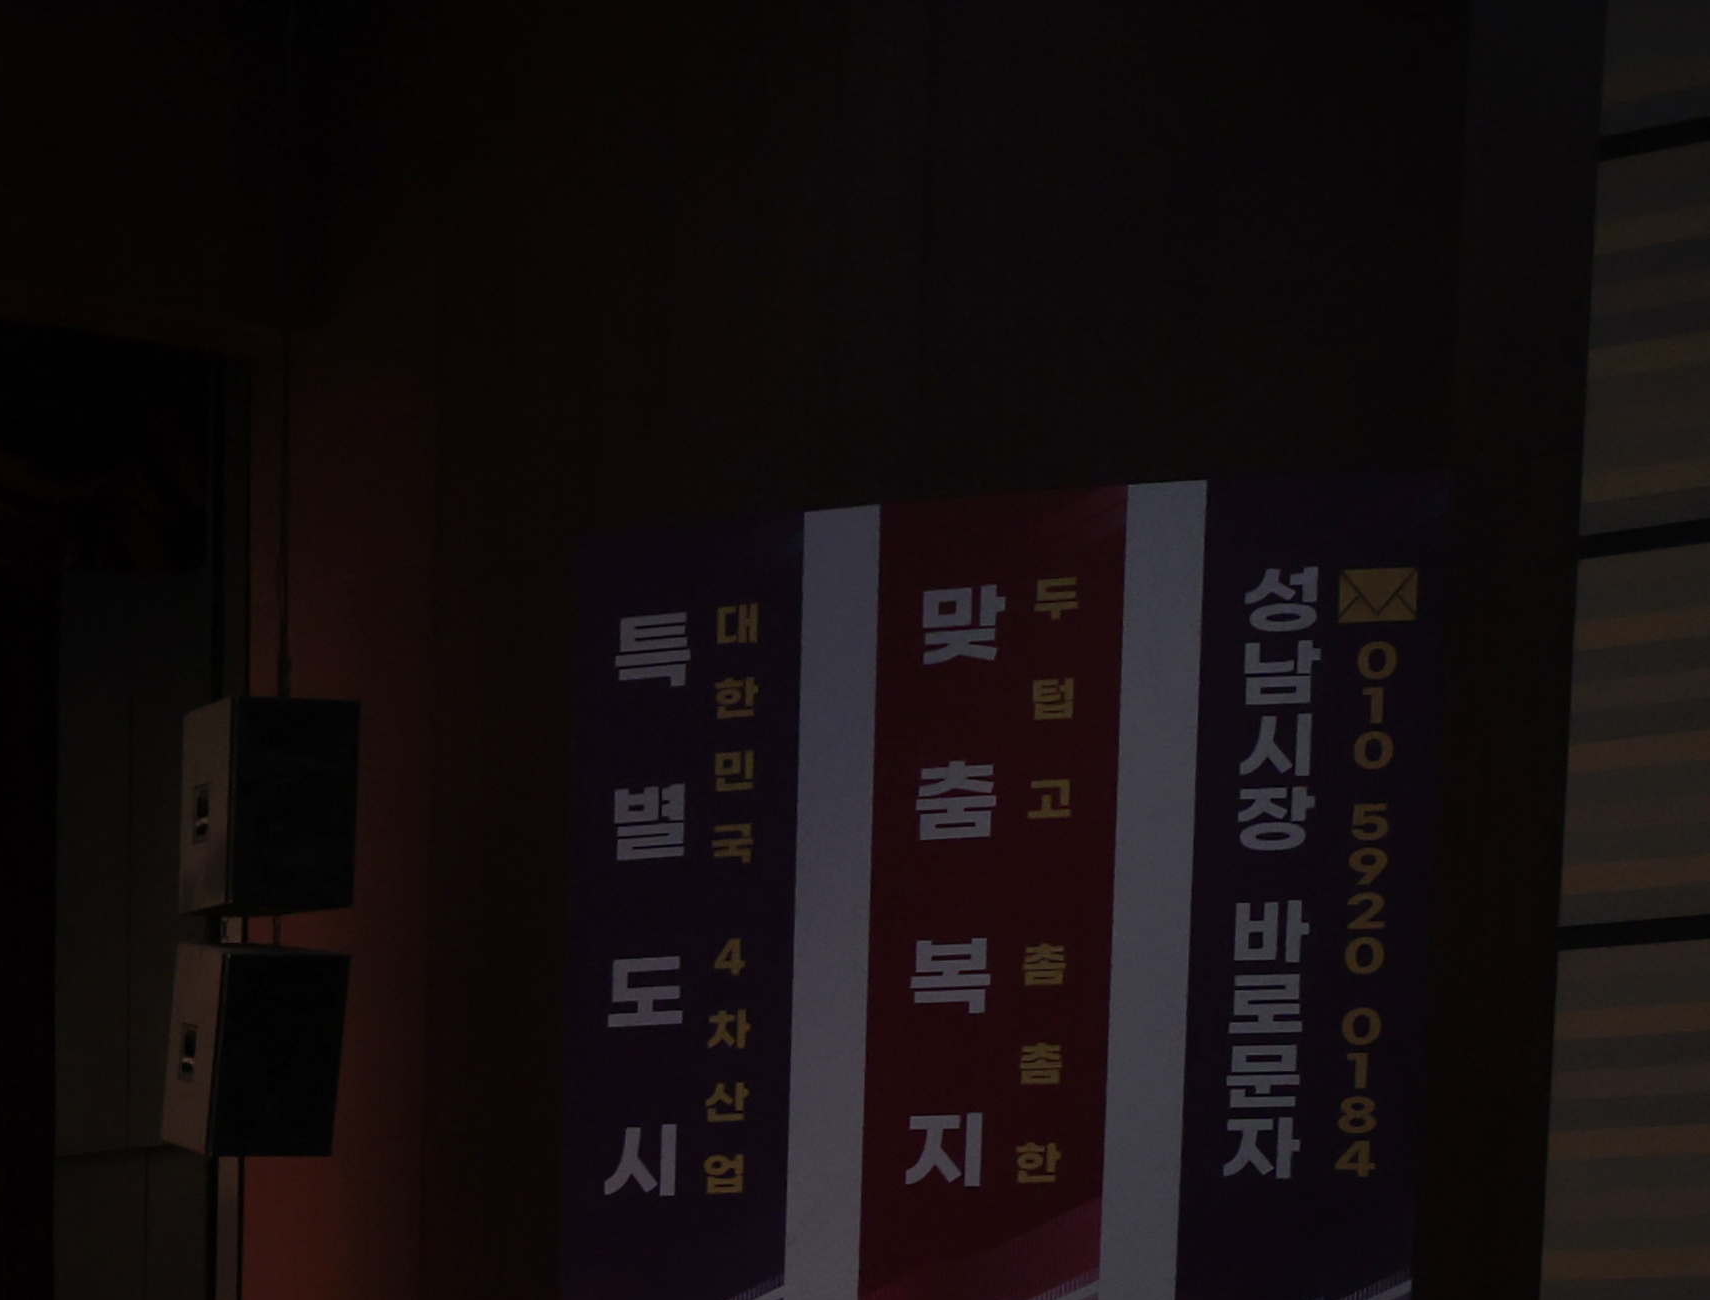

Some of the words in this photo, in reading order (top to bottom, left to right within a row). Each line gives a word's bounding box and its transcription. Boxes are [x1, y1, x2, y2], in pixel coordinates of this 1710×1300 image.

[712, 603, 759, 864] 대한민국
[1027, 576, 1079, 820] 두텁고
[1238, 566, 1322, 852] 성남시장
[1353, 640, 1398, 771] 010
[604, 611, 692, 1198] 특별도시
[905, 584, 1006, 1189] 맞춤복지
[1343, 803, 1389, 976] 5920
[703, 938, 751, 1195] 4차산업
[1016, 943, 1066, 1185] 촘촘한
[1223, 899, 1310, 1180] 바로문자
[1335, 1007, 1381, 1178] 0184
